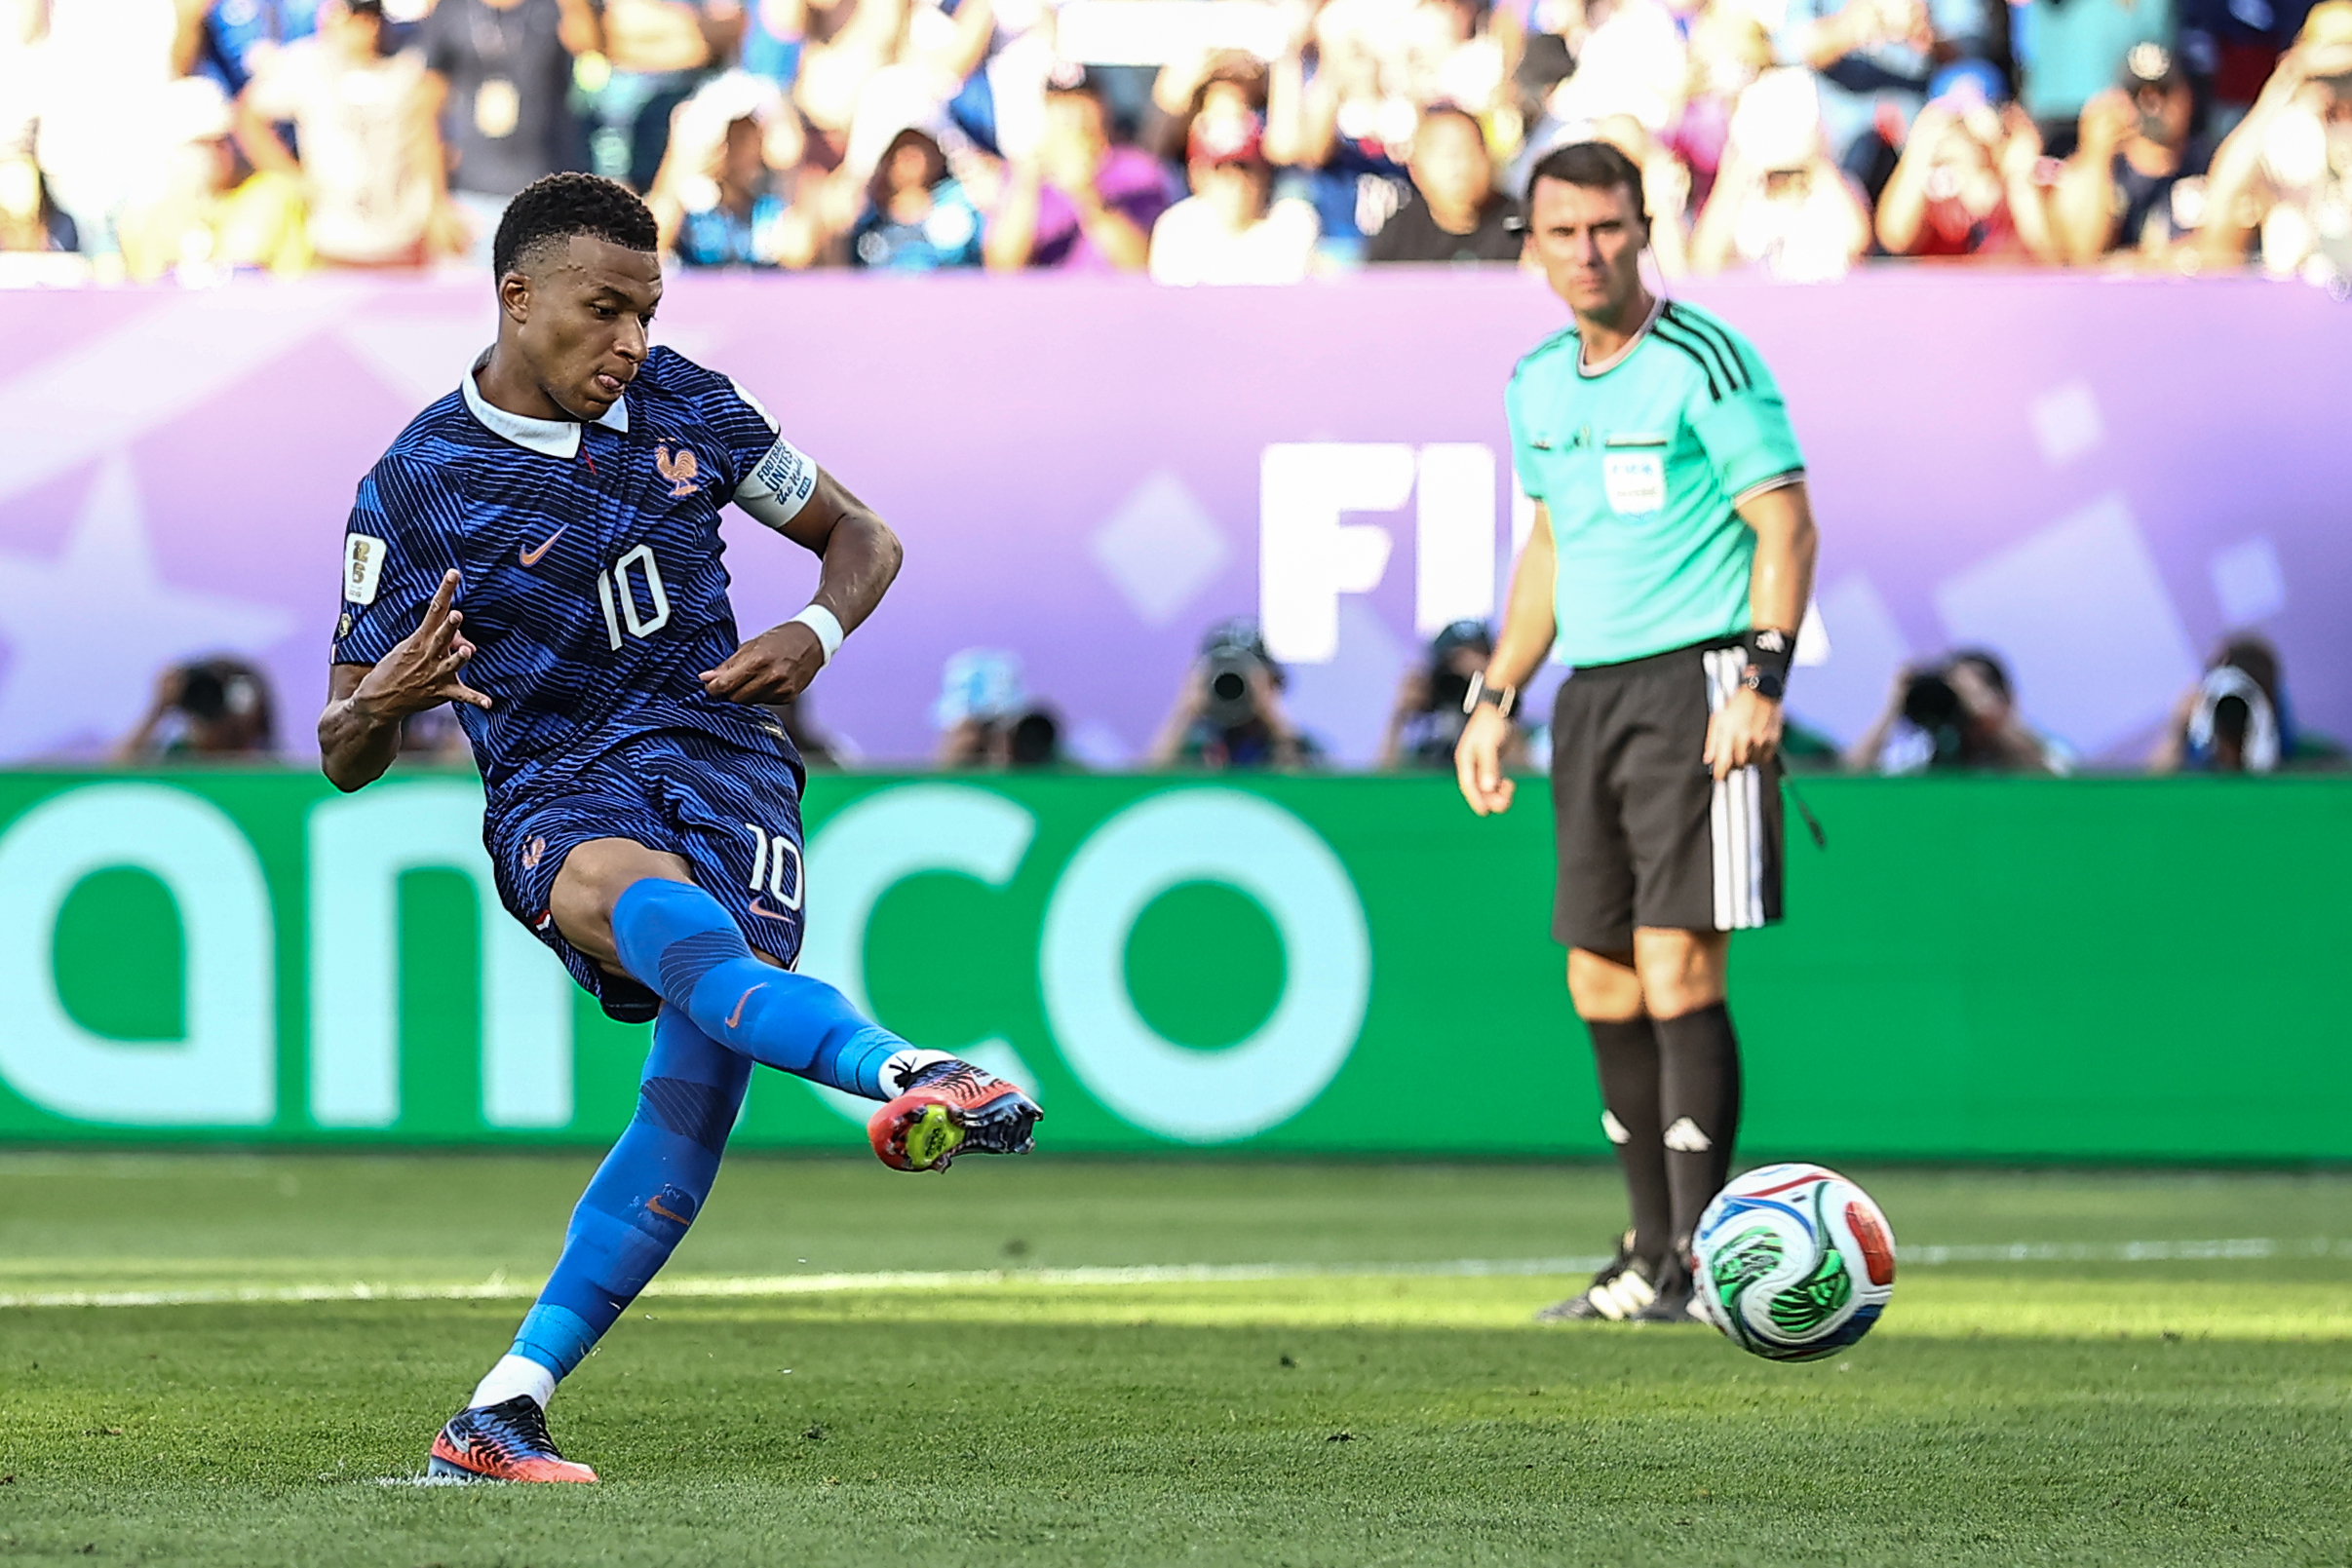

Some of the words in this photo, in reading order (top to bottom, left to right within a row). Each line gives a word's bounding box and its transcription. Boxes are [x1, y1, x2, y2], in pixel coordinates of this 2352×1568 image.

[764, 445, 792, 492] UNITES
[598, 544, 671, 652] 10
[1259, 441, 1831, 665] FI
[745, 822, 802, 911] 10
